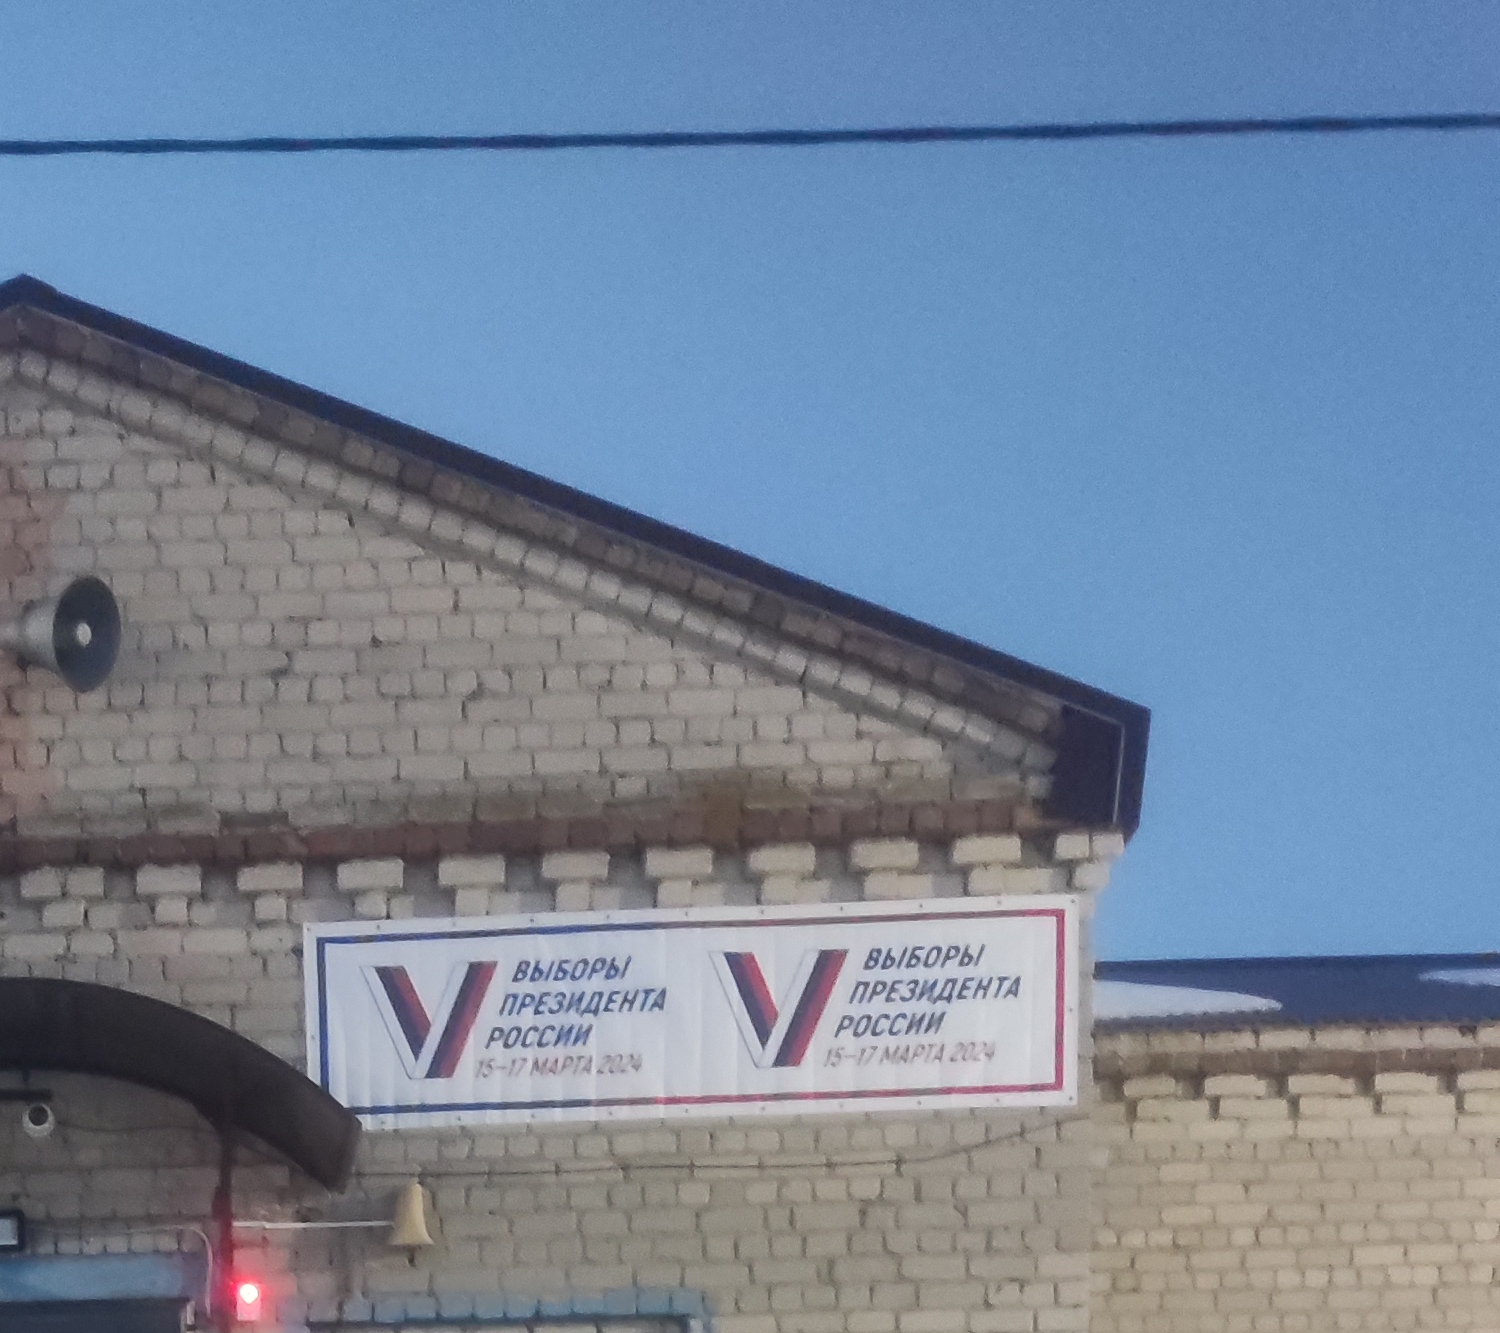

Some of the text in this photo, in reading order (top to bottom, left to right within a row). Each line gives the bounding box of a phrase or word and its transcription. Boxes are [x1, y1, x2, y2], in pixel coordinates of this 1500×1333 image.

[511, 956, 632, 983] ВЫБОРЫ
[863, 944, 986, 971] ВЫБОРЫ
[498, 987, 668, 1017] ПРЕЗИДЕНТА
[849, 975, 1022, 1005] ПРЕЗИДЕНТА
[485, 1024, 594, 1050] РОССИИ
[834, 1012, 947, 1039] РОССИИ
[530, 1055, 592, 1076] МАРТА
[596, 1053, 644, 1075] 2024
[879, 1043, 946, 1065] МАРТА
[949, 1040, 996, 1063] 2024
